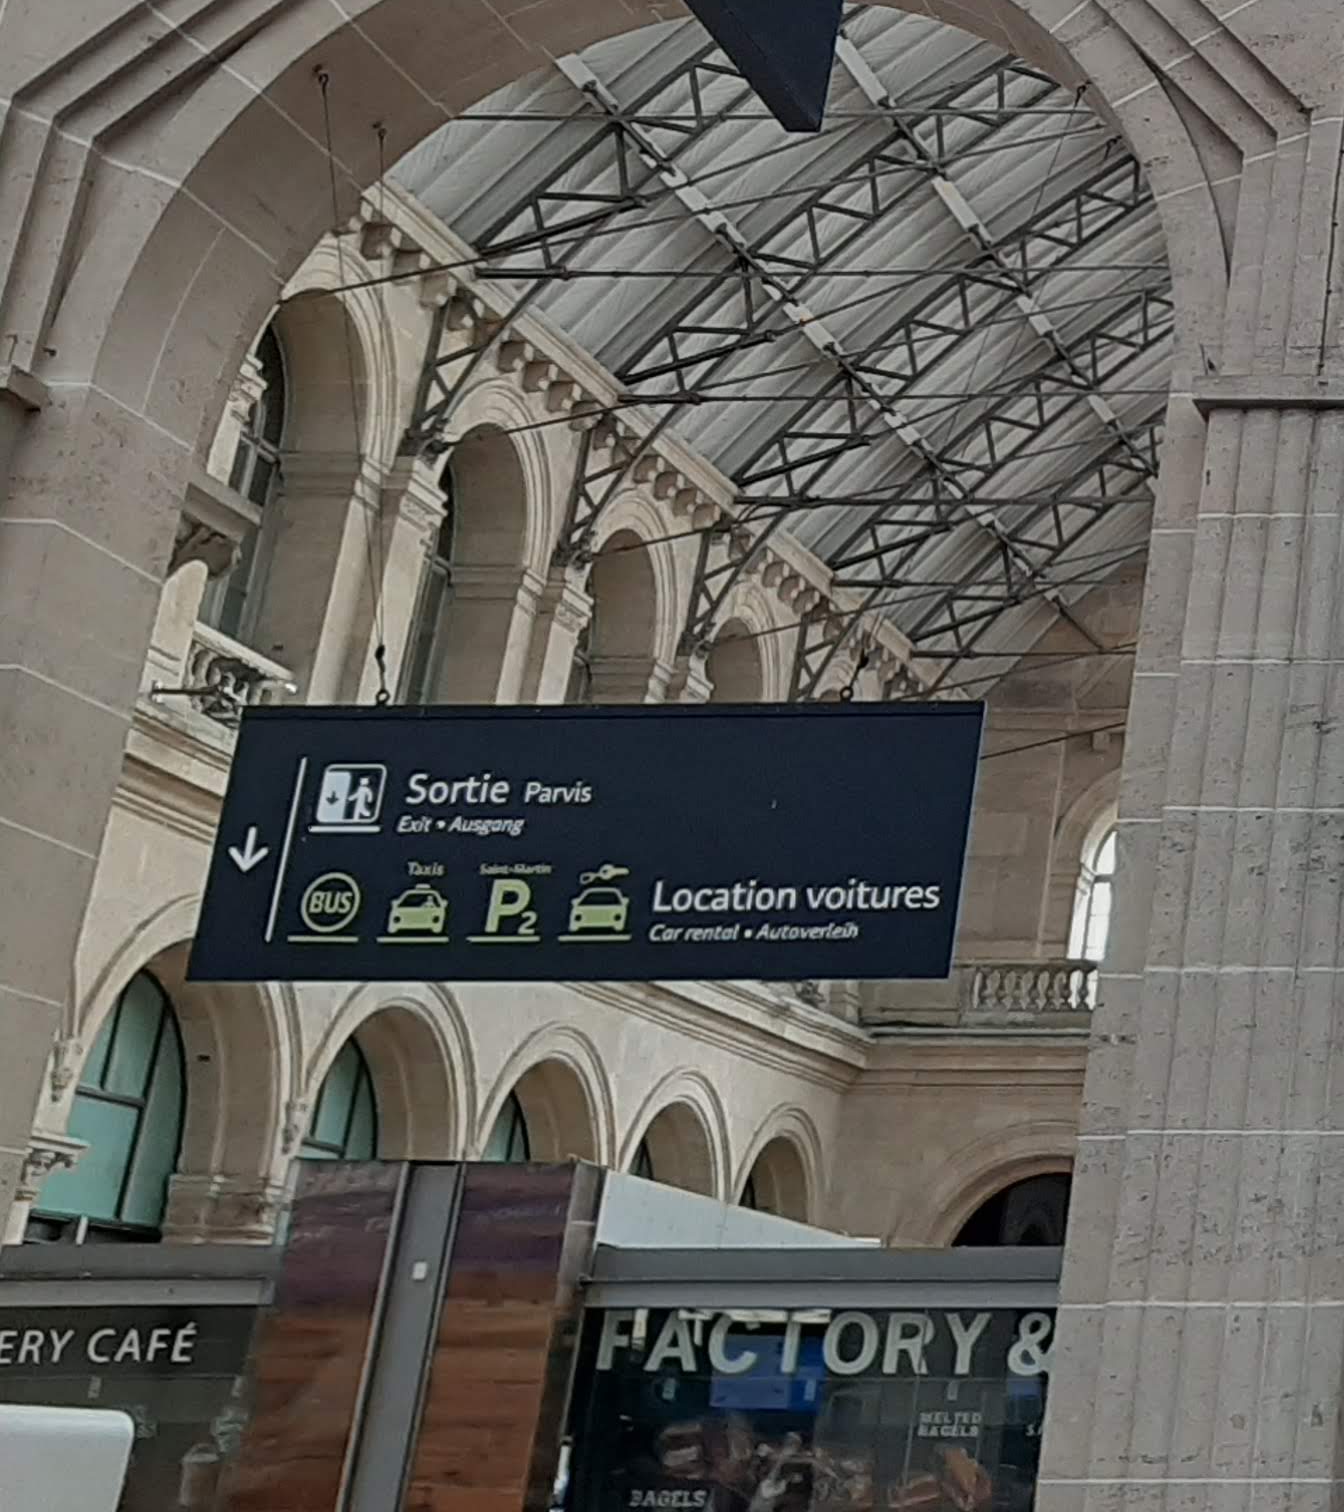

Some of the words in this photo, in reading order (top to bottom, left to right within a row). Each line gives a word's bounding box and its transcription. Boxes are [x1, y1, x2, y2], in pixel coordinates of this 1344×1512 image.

[405, 773, 510, 804] Sortie
[524, 781, 593, 803] Parvis
[396, 815, 432, 832] Exit
[447, 815, 525, 836] Ausgang
[407, 861, 444, 876] Taxis
[308, 890, 352, 914] BUS
[652, 880, 796, 912] Location
[806, 878, 941, 910] voitures
[649, 922, 678, 941] Car
[684, 922, 739, 941] rental
[755, 922, 859, 940] Autoverleih
[87, 1321, 198, 1364] CAFÉ
[596, 1308, 993, 1375] FACTORY
[1007, 1312, 1054, 1376] &
[629, 1489, 708, 1508] BAGELS
